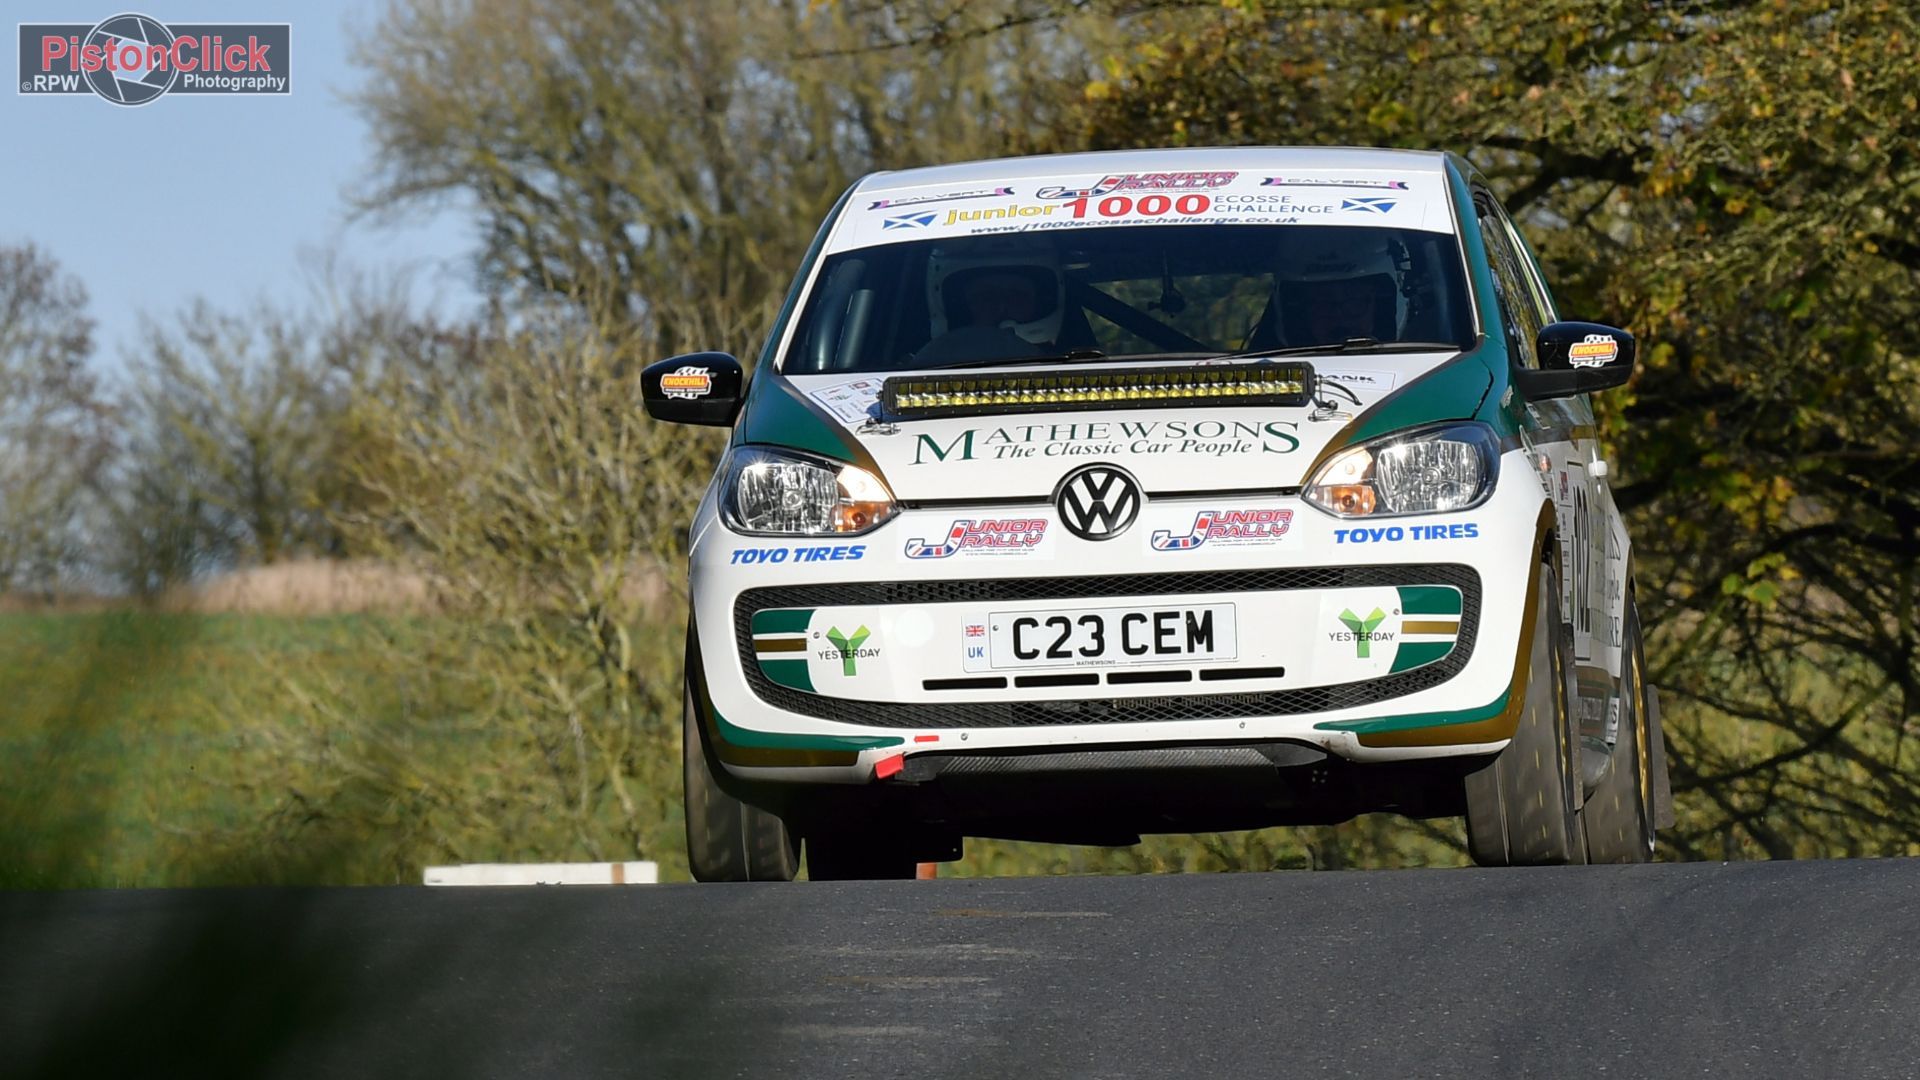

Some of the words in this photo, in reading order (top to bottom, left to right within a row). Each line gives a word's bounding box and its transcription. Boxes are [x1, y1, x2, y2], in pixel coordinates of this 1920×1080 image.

[1214, 195, 1291, 204] ECOSSE
[1214, 204, 1334, 214] CHALLENGE
[908, 421, 1300, 465] MATHEWSONS
[993, 445, 1036, 460] The
[1044, 440, 1123, 456] Classic
[1130, 440, 1173, 454] Car
[1178, 439, 1253, 456] People
[1206, 524, 1290, 538] RALLY
[1334, 526, 1404, 544] TOYO
[1409, 523, 1479, 540] TIRES
[961, 533, 1043, 547] RALLY
[731, 549, 786, 564] TOYO
[792, 545, 867, 562] TIRES
[1012, 614, 1105, 660] C23
[1121, 610, 1214, 656] CEM
[1329, 632, 1394, 641] YESTERDAY
[818, 648, 880, 660] YESTERDAY
[968, 647, 984, 658] UK
